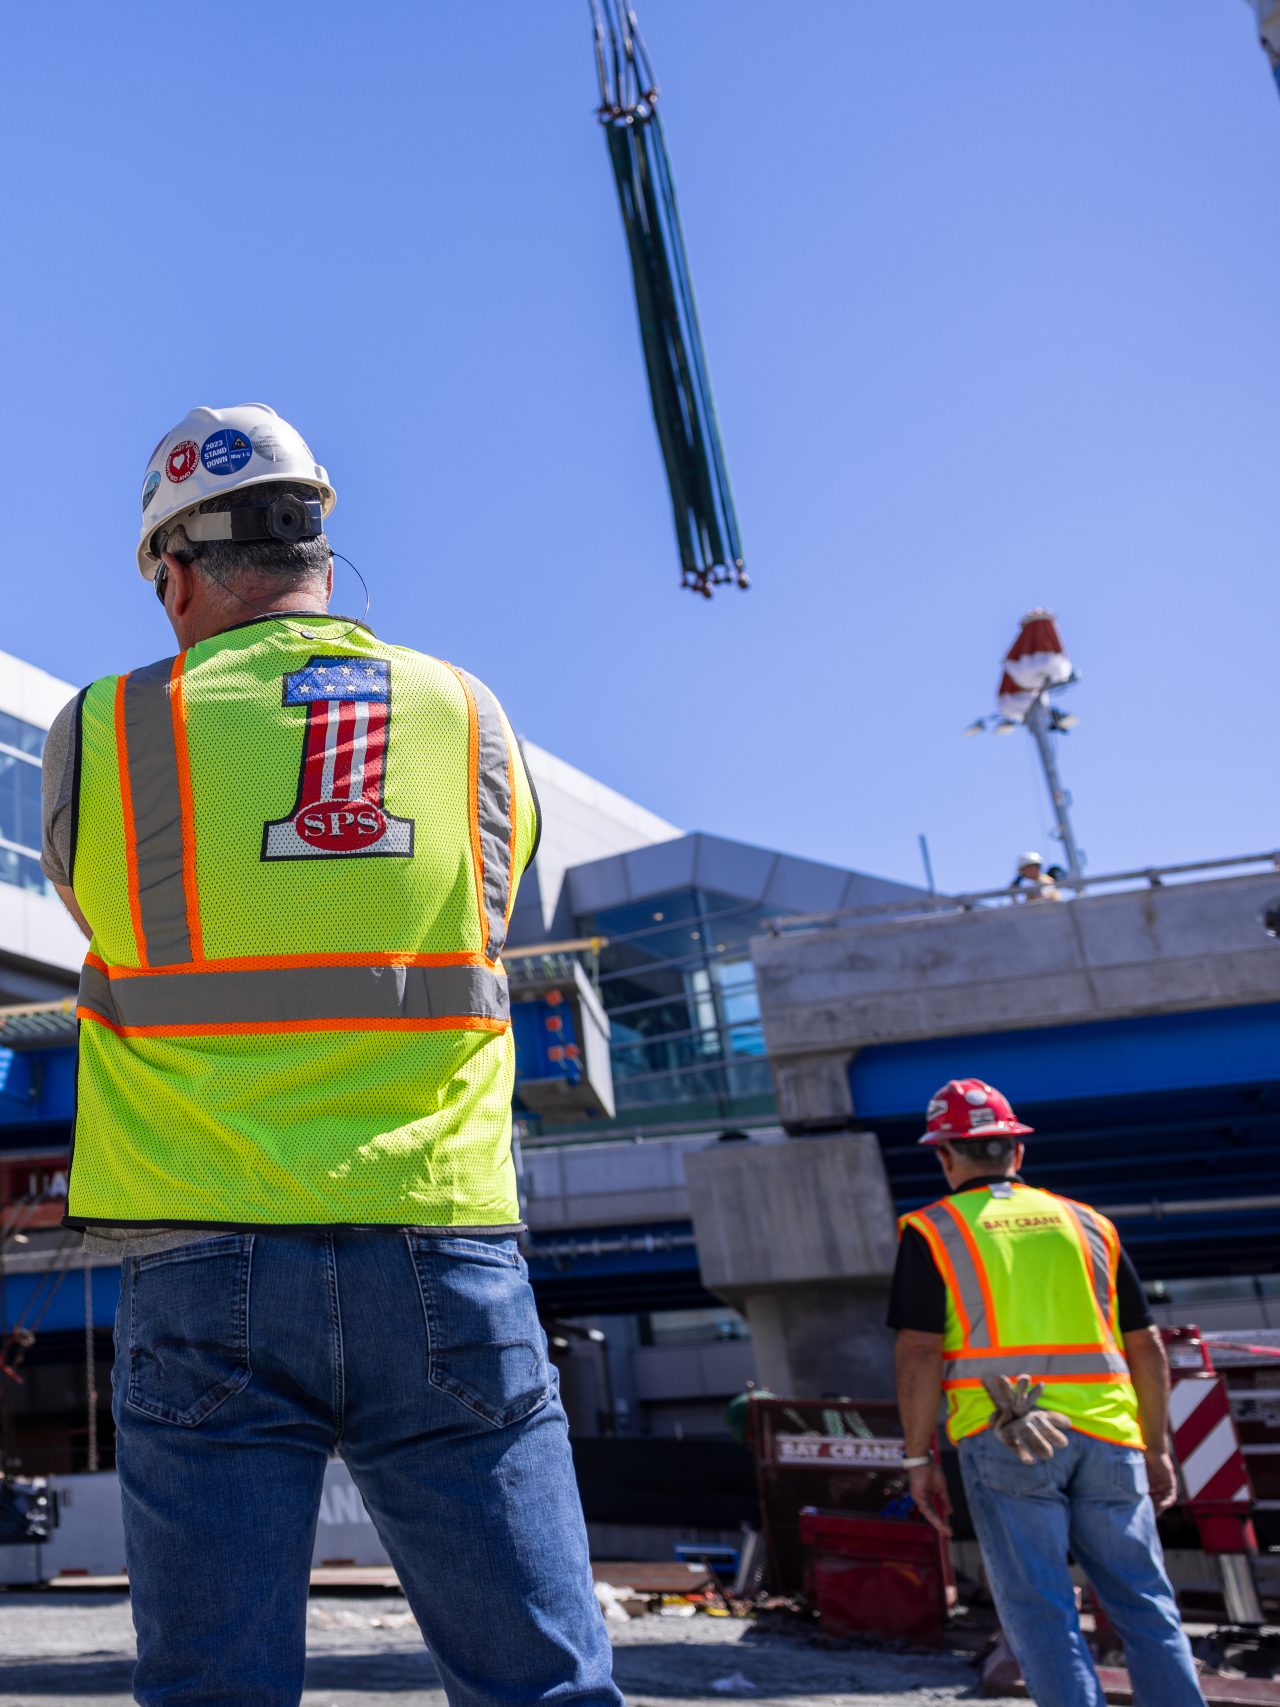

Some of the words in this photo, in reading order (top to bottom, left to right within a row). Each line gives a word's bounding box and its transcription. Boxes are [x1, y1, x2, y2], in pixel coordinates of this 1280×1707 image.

[205, 440, 223, 451] 2023
[204, 447, 227, 460] STAND
[206, 455, 228, 469] DOWN
[303, 811, 380, 838] SPS
[983, 1219, 1009, 1230] BAY
[1015, 1216, 1062, 1228] CRANE
[782, 1442, 819, 1458] BAY
